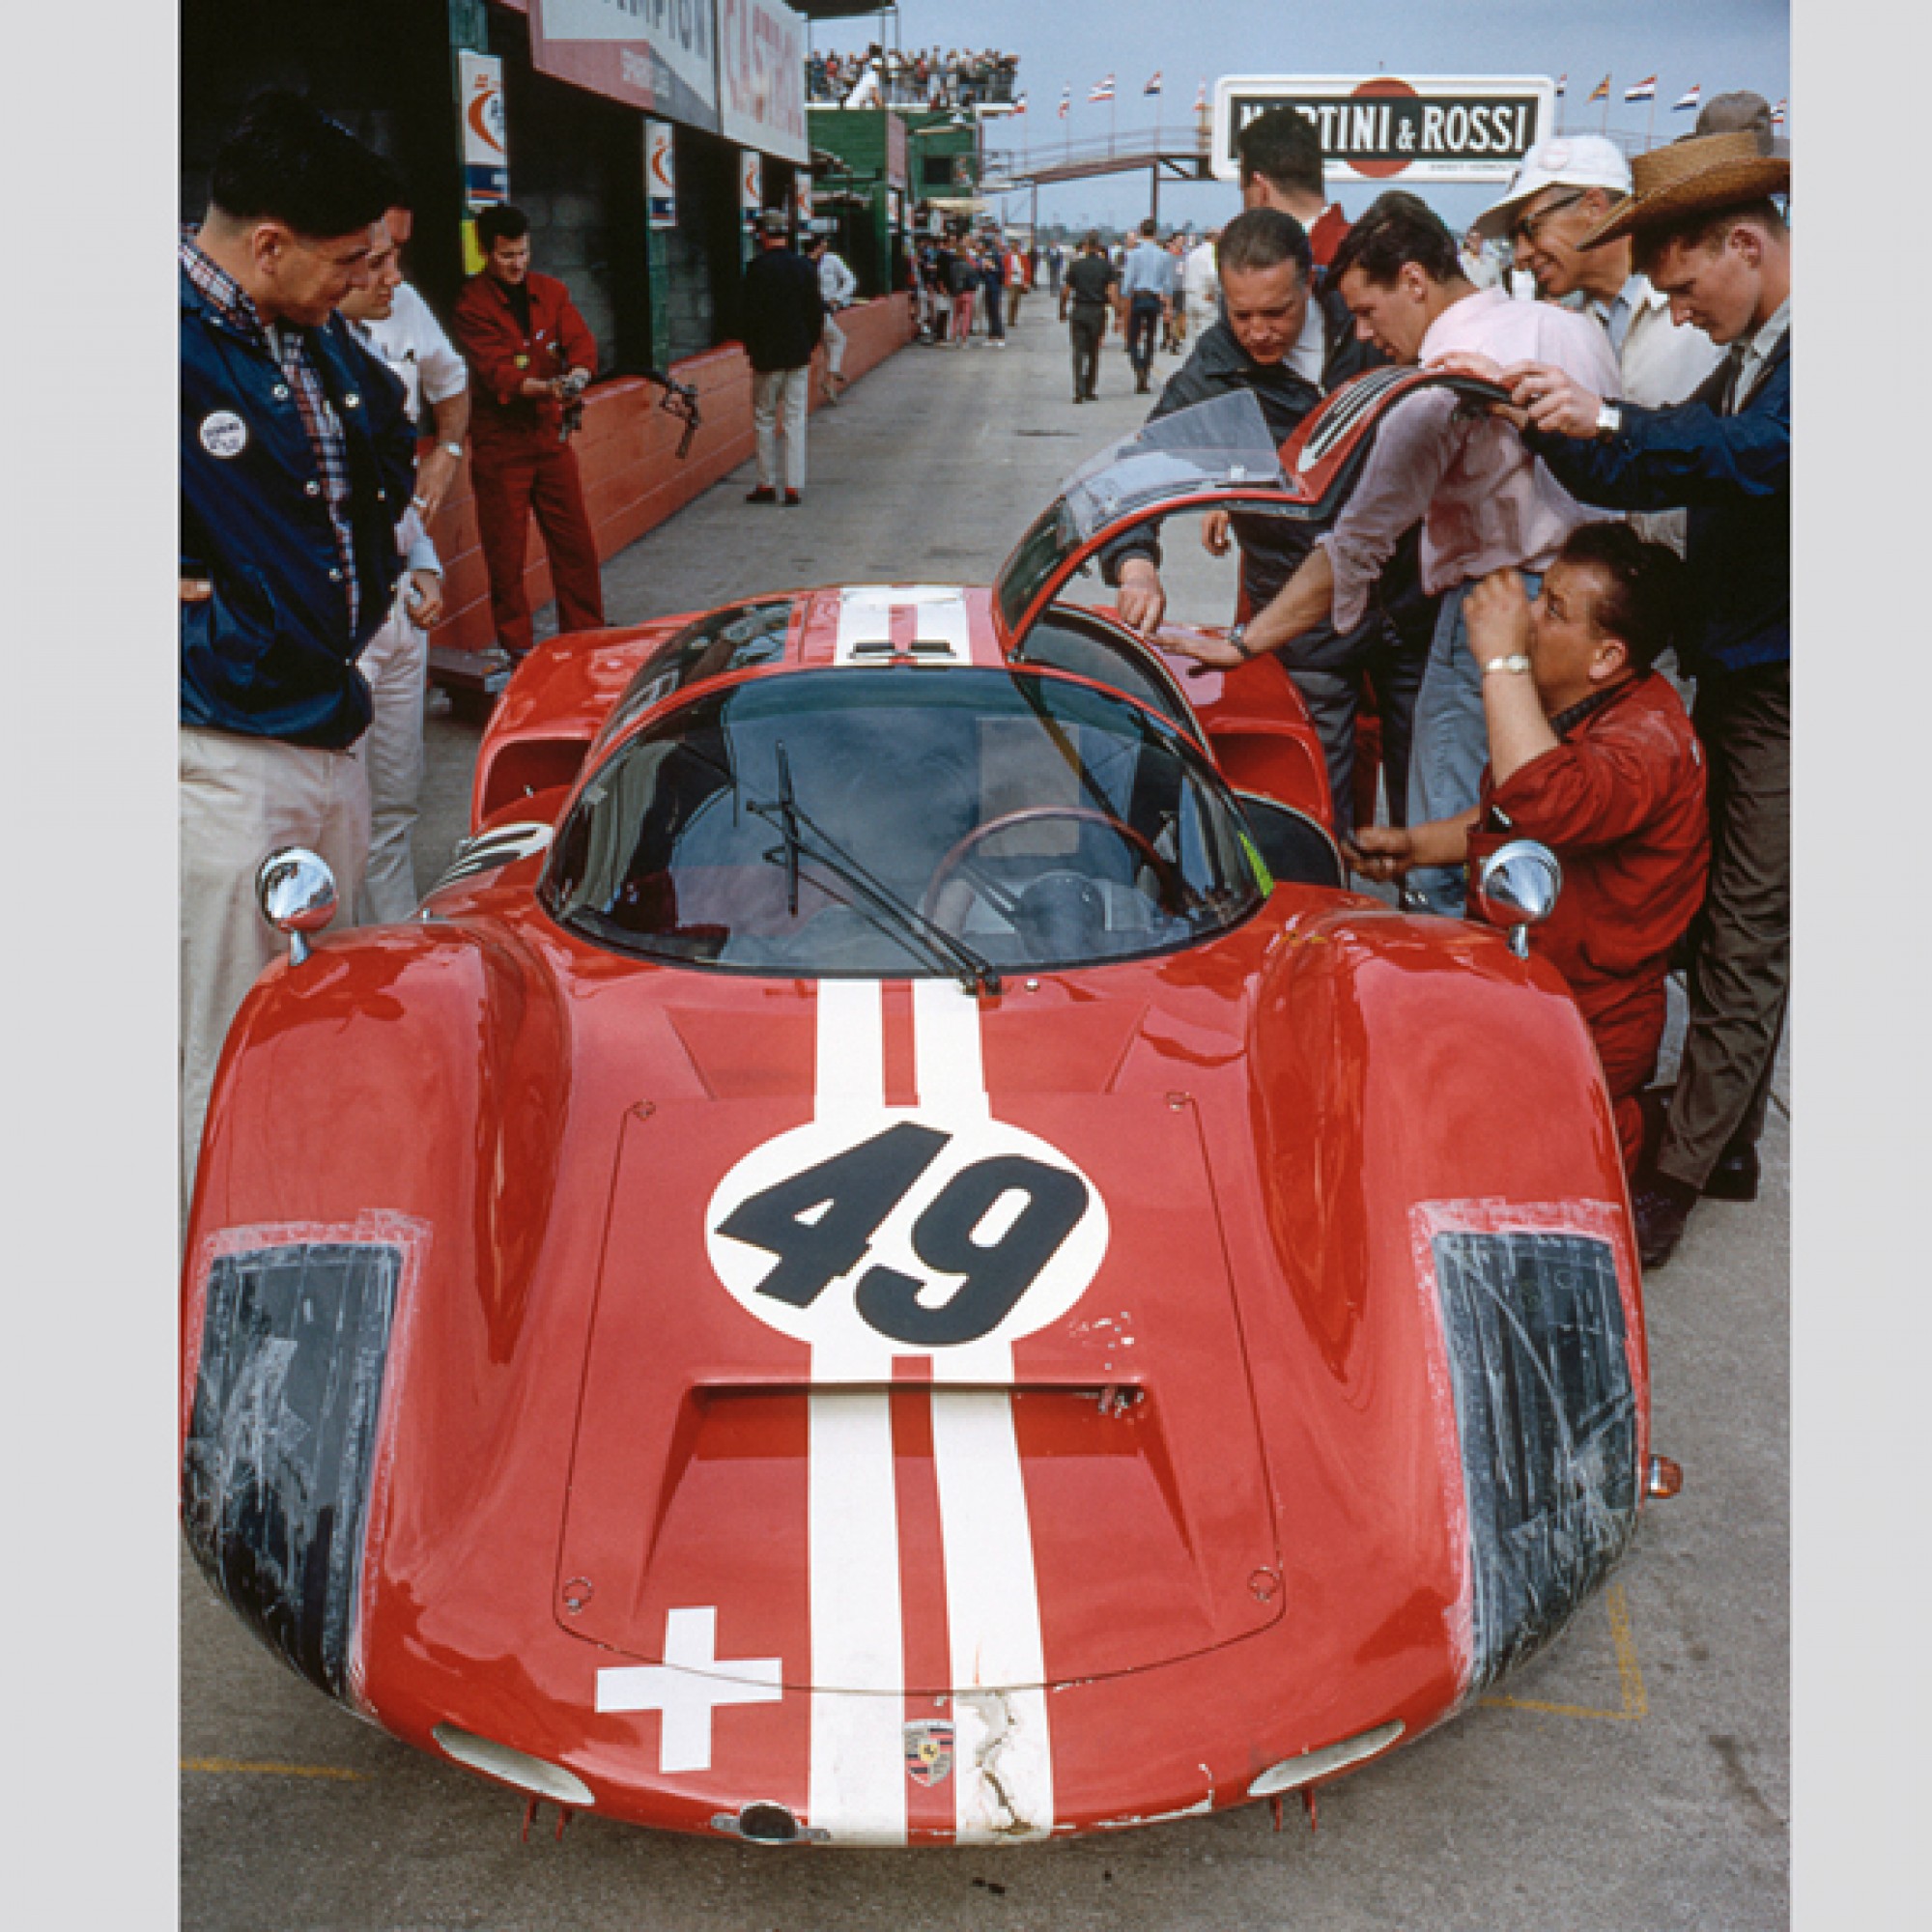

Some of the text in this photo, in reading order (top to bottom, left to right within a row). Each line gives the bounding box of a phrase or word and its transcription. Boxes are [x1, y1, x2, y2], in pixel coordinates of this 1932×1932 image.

[1395, 117, 1416, 152] &
[1420, 102, 1528, 152] ROSSI
[714, 1121, 1090, 1347] 49
